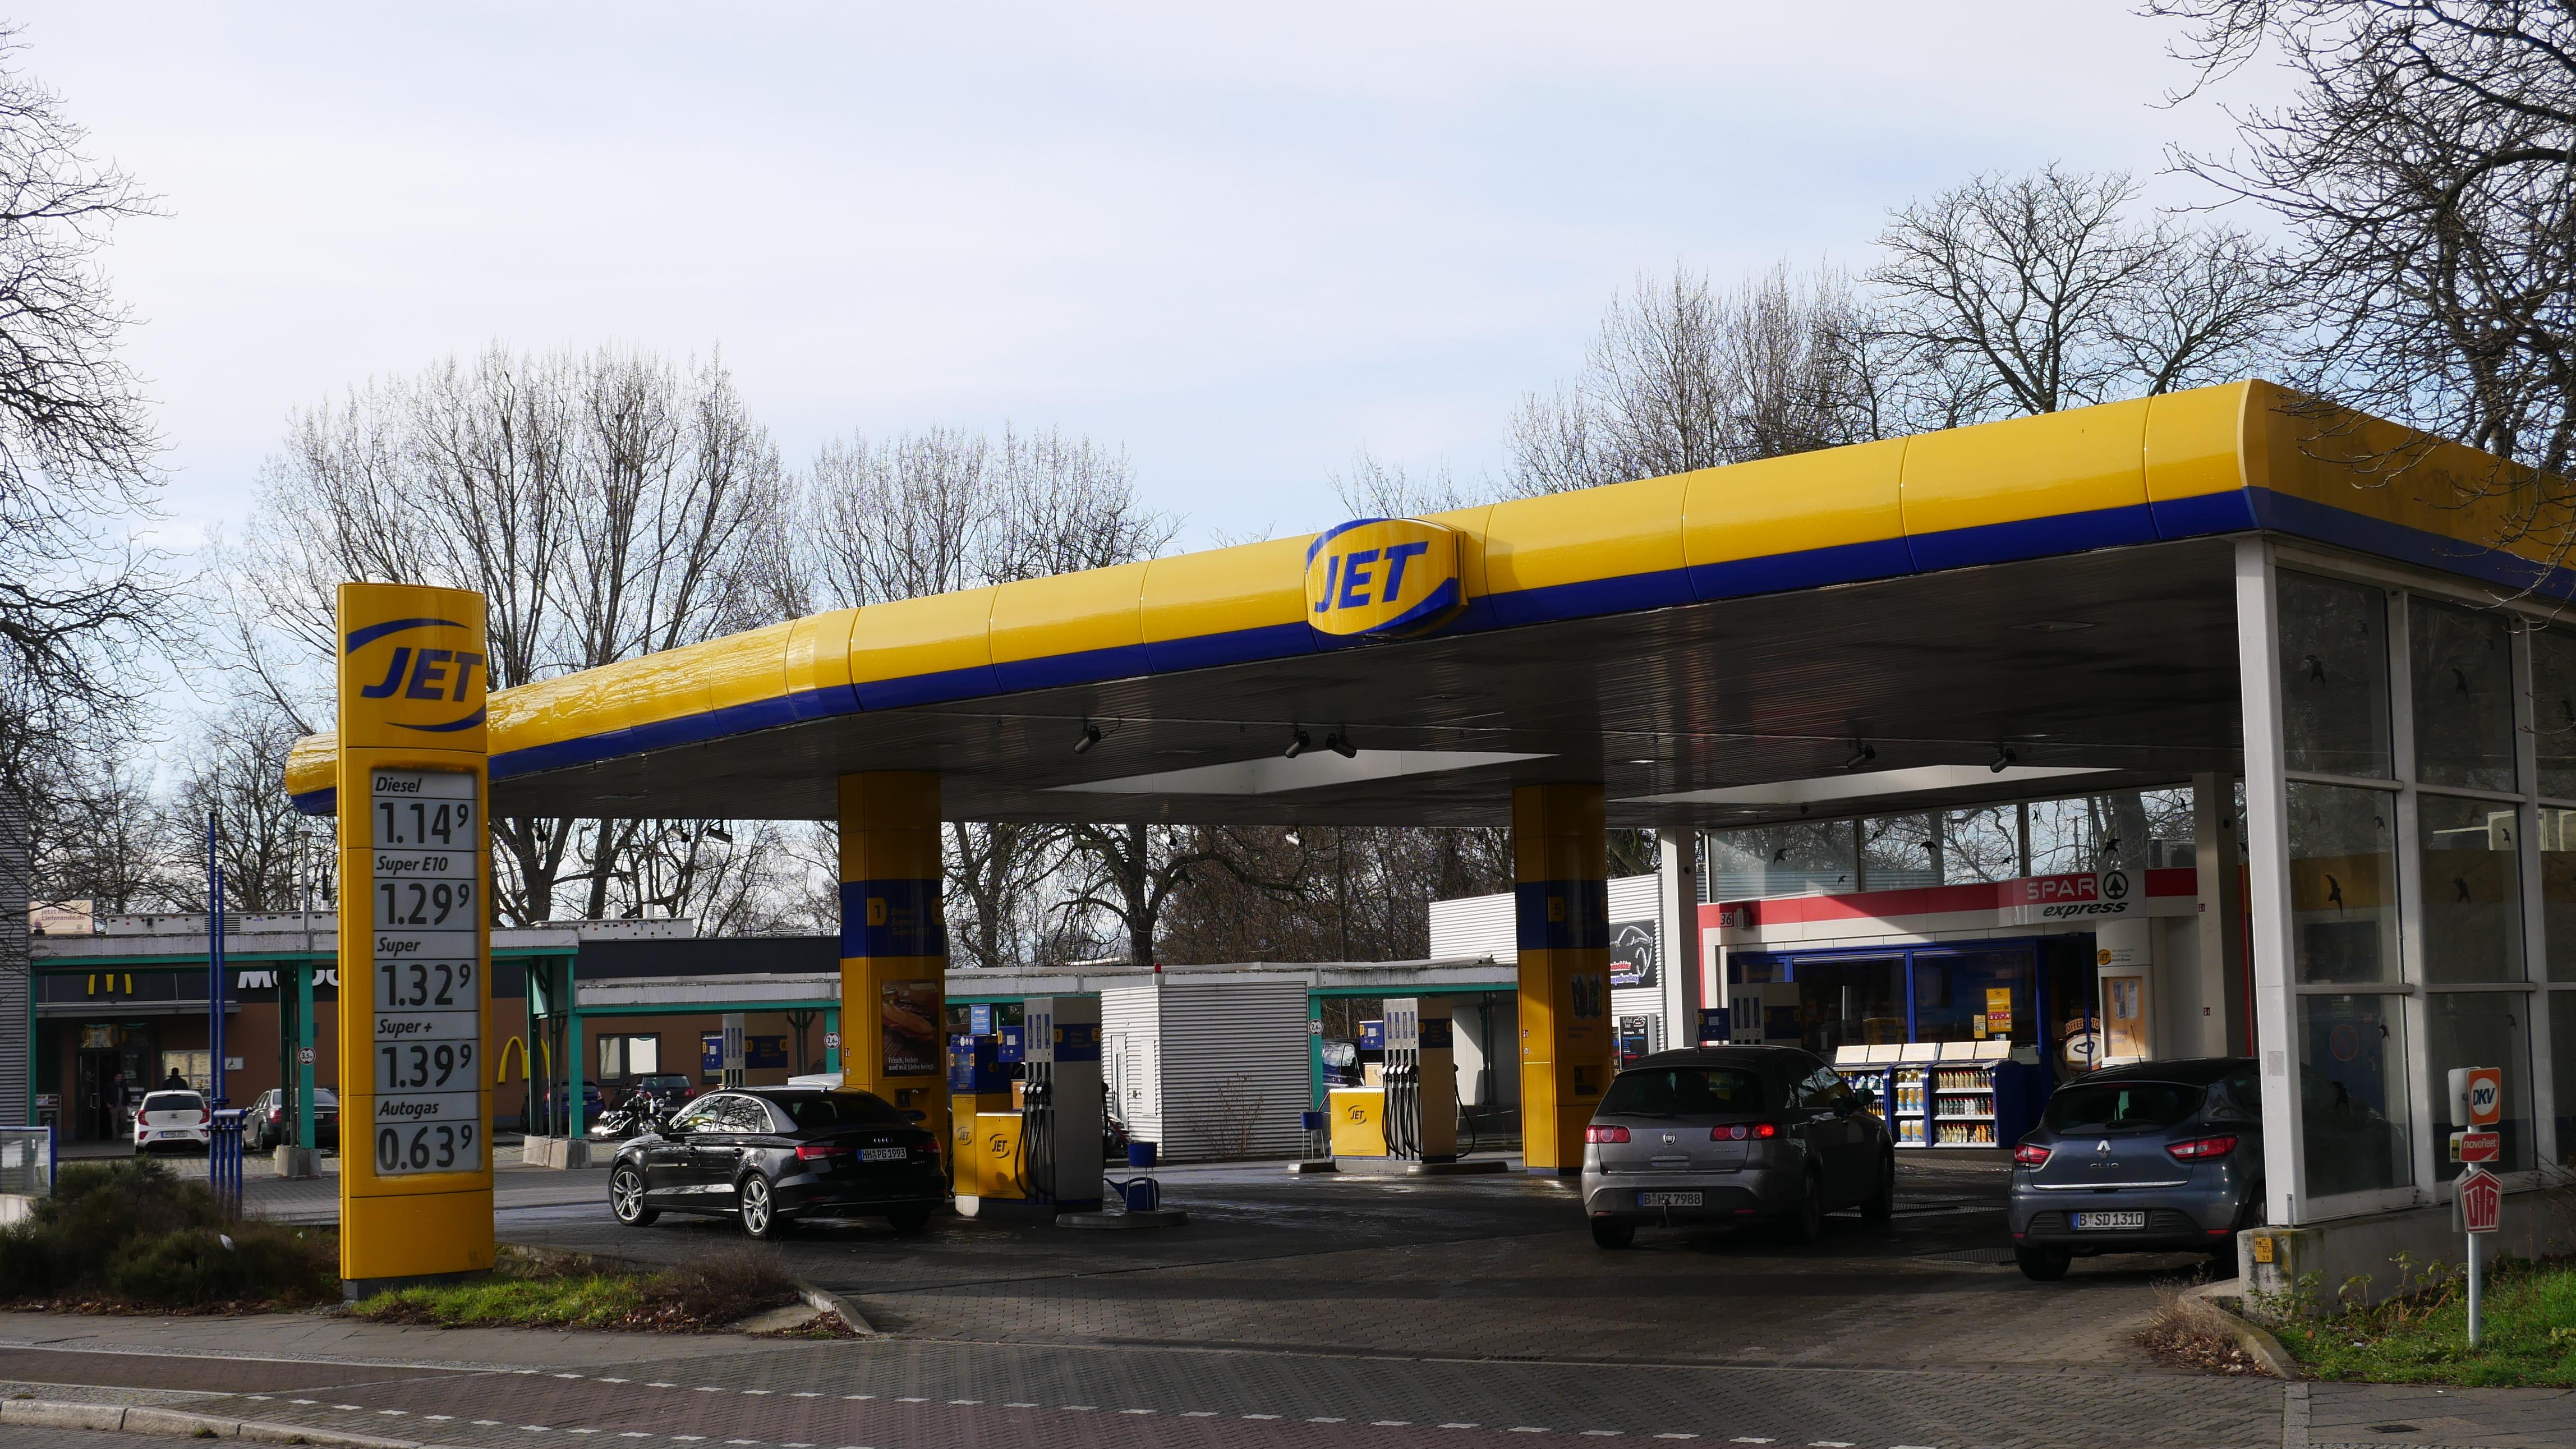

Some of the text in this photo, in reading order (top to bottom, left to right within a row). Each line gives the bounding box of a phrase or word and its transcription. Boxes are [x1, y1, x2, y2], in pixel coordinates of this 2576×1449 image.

[1314, 541, 1429, 613] JET
[361, 647, 484, 702] JET
[375, 776, 422, 793] Diesel
[376, 855, 448, 875] Super E10
[2027, 877, 2096, 900] SPAR
[874, 905, 880, 918] 1
[1554, 903, 1561, 915] 5
[2043, 902, 2129, 919] express
[1721, 914, 1732, 925] 36
[378, 937, 421, 957] Super
[378, 1019, 432, 1038] Super +
[2066, 1019, 2083, 1034] OFFEE
[1055, 1030, 1060, 1040] 1
[889, 1056, 905, 1065] Frisch,
[2473, 1088, 2496, 1106] DKV
[379, 1101, 439, 1119] Autogas
[1350, 1110, 1364, 1120] JET
[958, 1131, 970, 1141] JET
[992, 1140, 1008, 1152] JET
[863, 1151, 872, 1159] HH
[1644, 1194, 1651, 1204] B
[1674, 1194, 1700, 1204] 7988
[2463, 1175, 2500, 1229] UTA
[2079, 1213, 2143, 1226] B SD 1310
